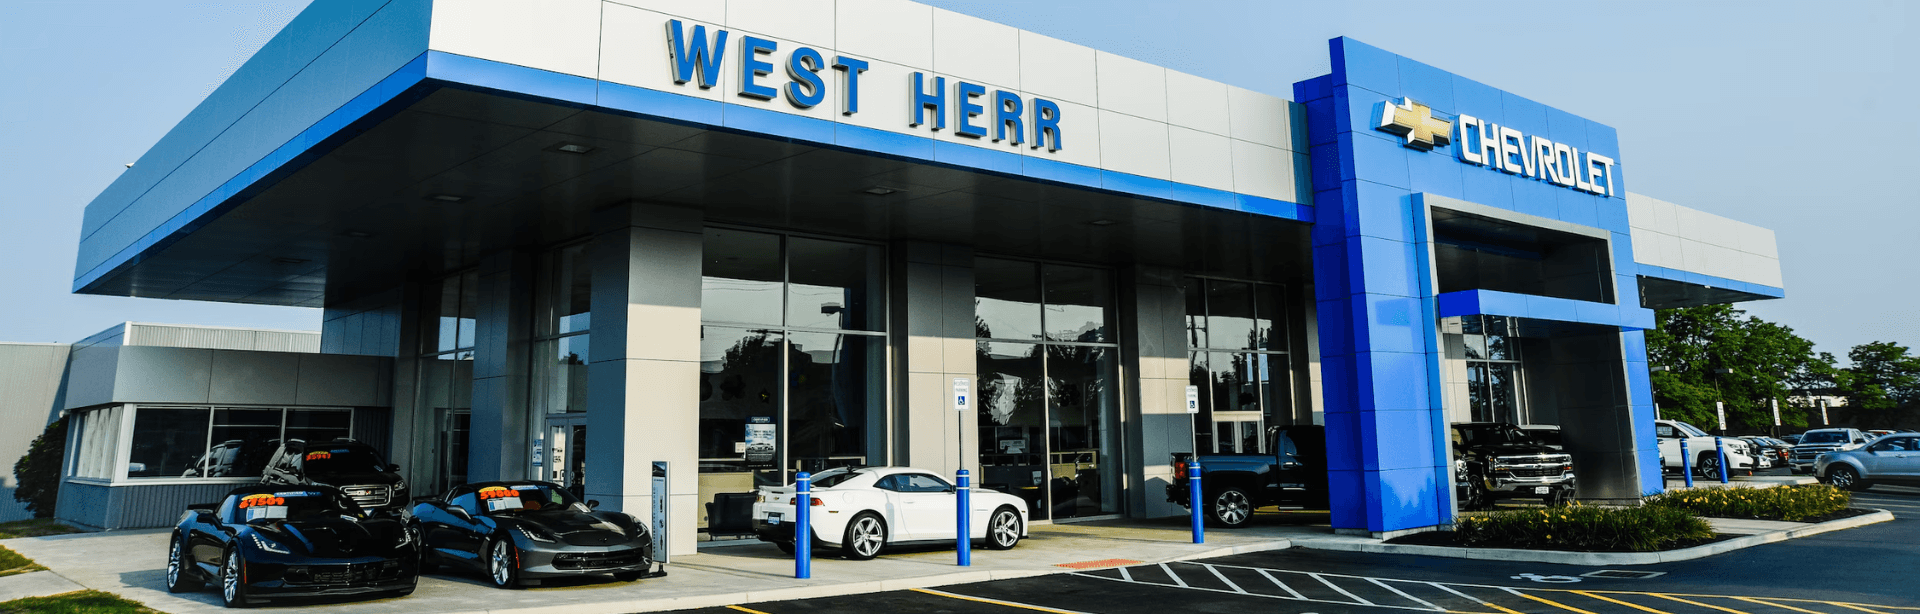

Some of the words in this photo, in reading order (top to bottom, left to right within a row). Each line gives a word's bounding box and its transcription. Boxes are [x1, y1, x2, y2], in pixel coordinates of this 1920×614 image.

[665, 19, 869, 116] WEST
[908, 71, 1063, 153] HERR
[1458, 113, 1614, 197] CHEVROLET
